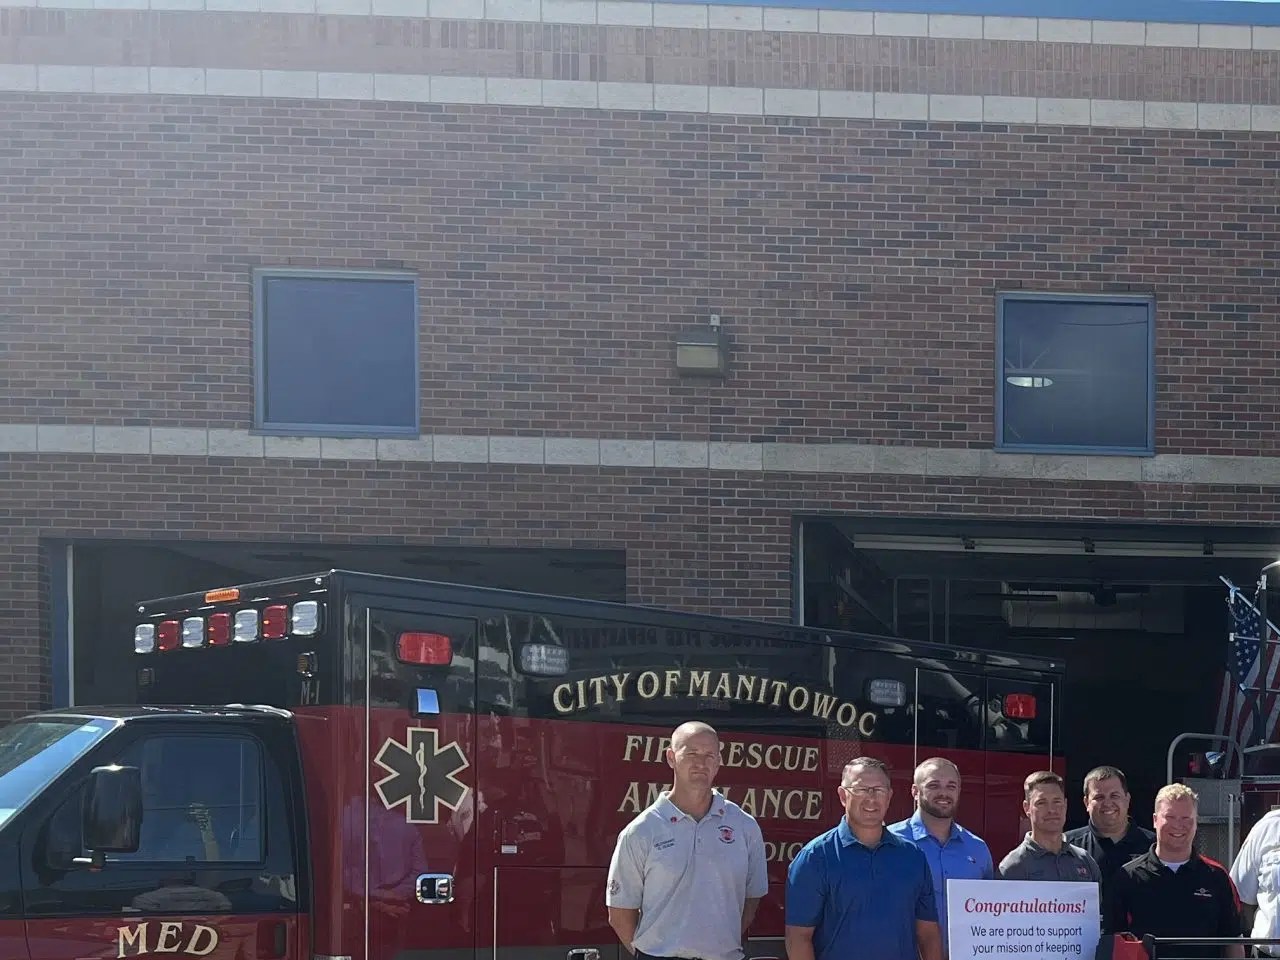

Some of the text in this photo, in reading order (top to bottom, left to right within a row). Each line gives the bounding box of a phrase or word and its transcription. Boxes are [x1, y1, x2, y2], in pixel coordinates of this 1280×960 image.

[553, 670, 877, 736] CITY OF MANITOWOC
[964, 898, 1086, 916] Congratulations!
[117, 922, 219, 959] MED
[971, 926, 1082, 941] We are proud to support
[973, 942, 1082, 956] your mission of keeping
